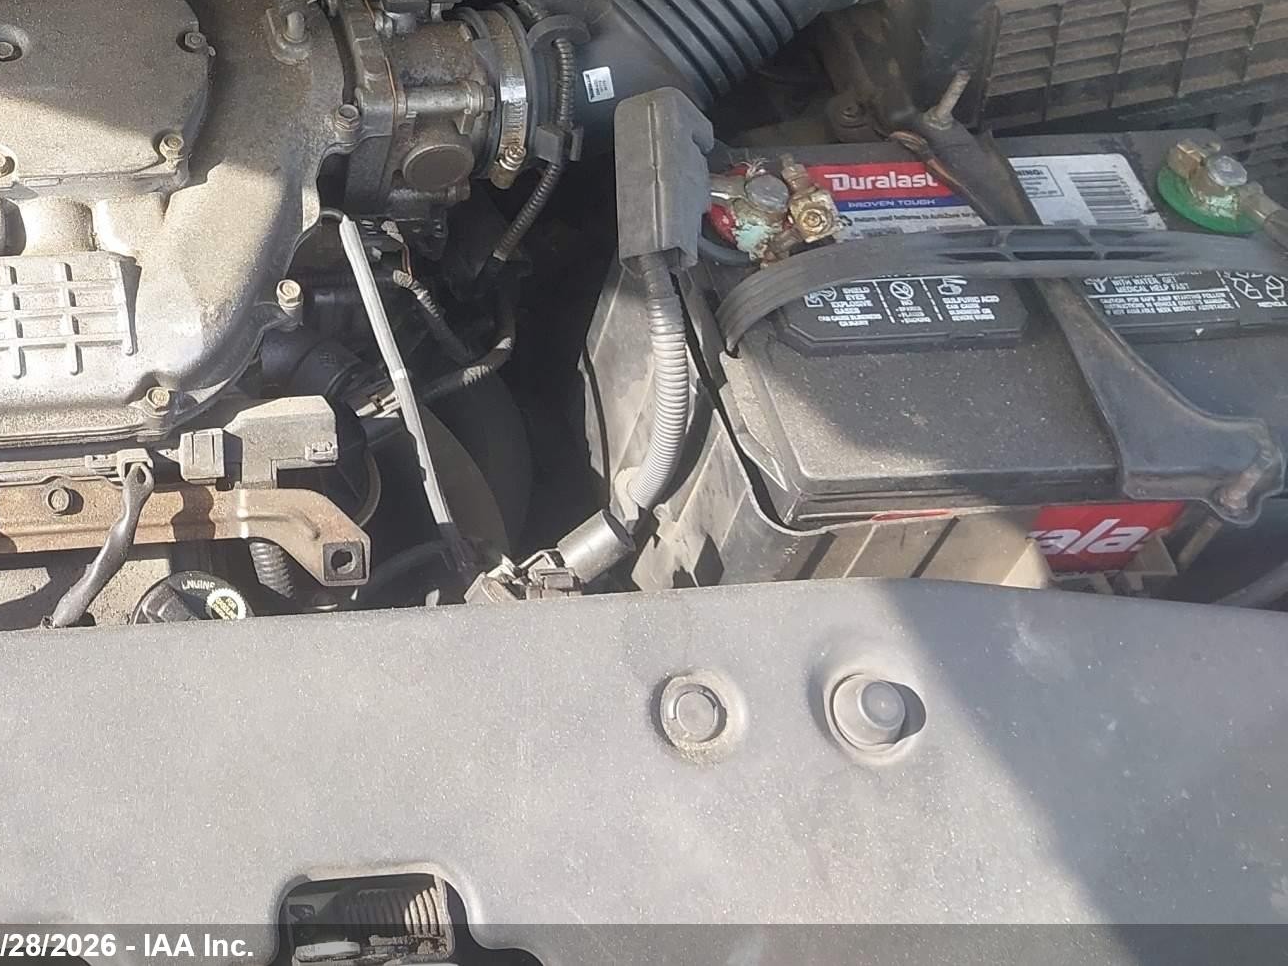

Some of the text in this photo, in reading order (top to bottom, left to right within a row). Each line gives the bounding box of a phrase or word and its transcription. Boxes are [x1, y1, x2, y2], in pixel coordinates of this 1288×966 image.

[824, 171, 938, 192] Duralast
[848, 198, 936, 208] PROVEN TOUGH
[1027, 519, 1149, 554] ala
